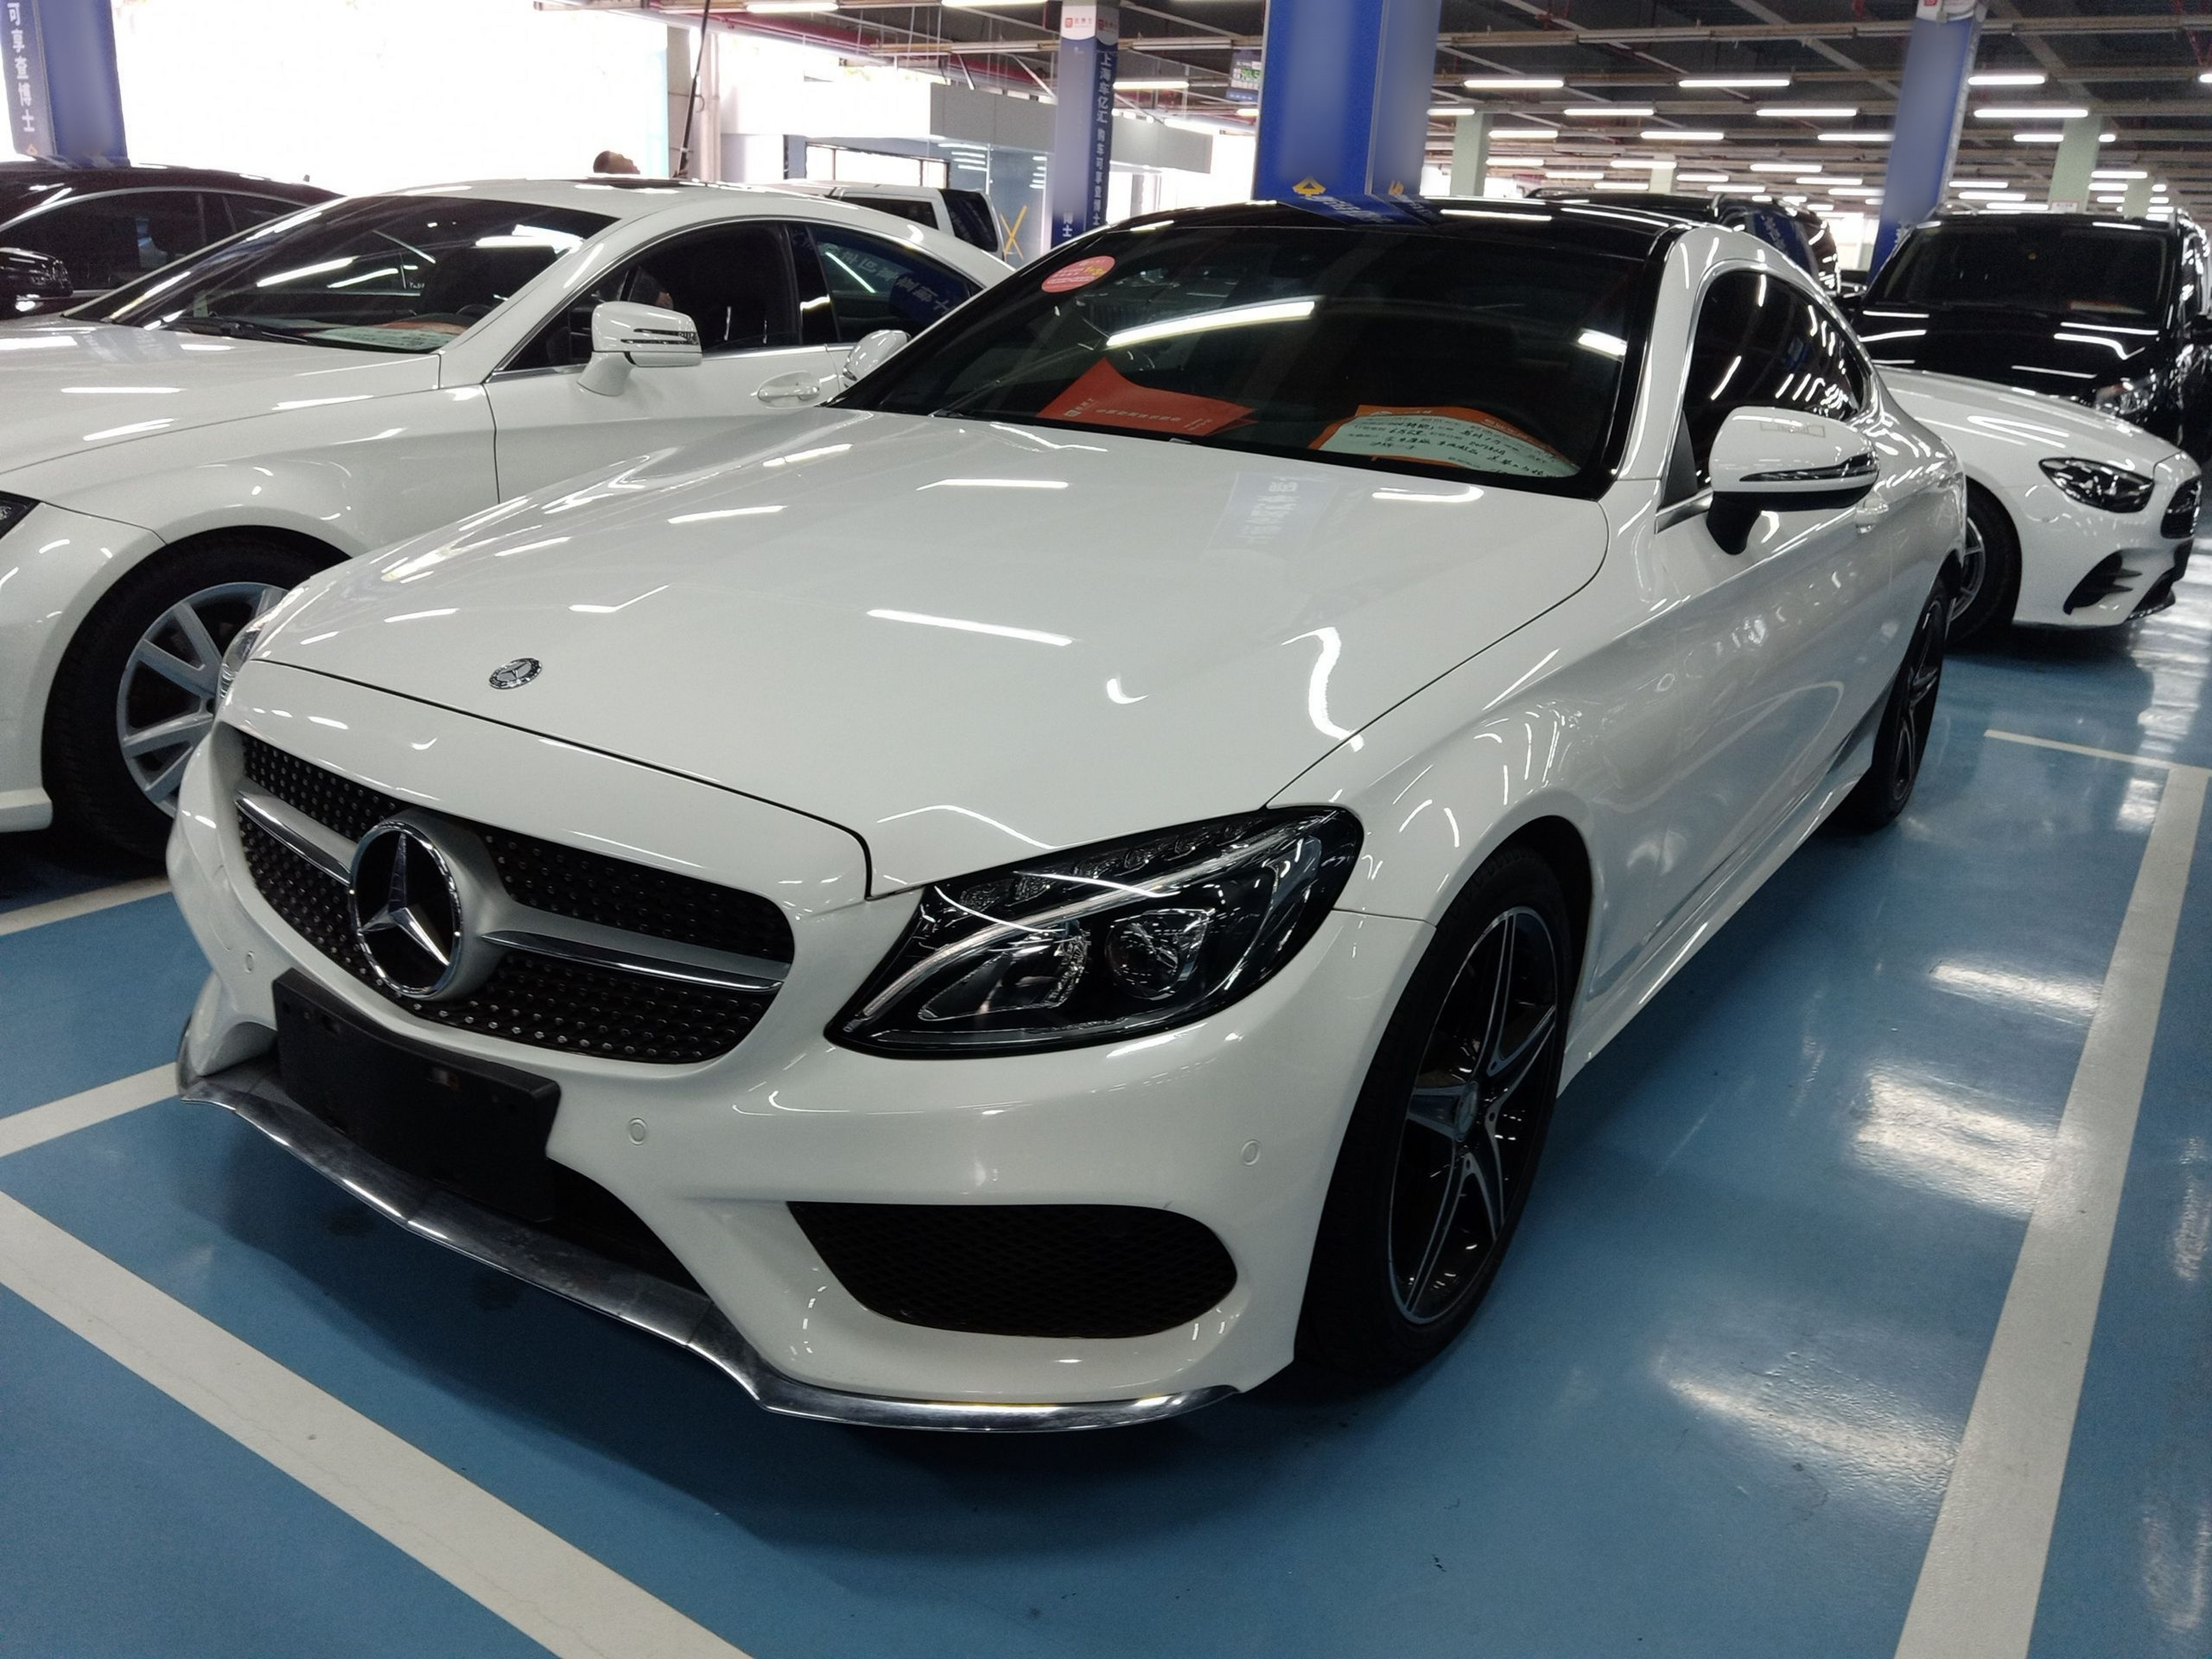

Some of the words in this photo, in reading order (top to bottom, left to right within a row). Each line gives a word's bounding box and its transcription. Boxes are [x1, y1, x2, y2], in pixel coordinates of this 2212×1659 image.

[7, 2, 35, 132] 可享查博士
[1096, 52, 1112, 124] 上海车亿汇
